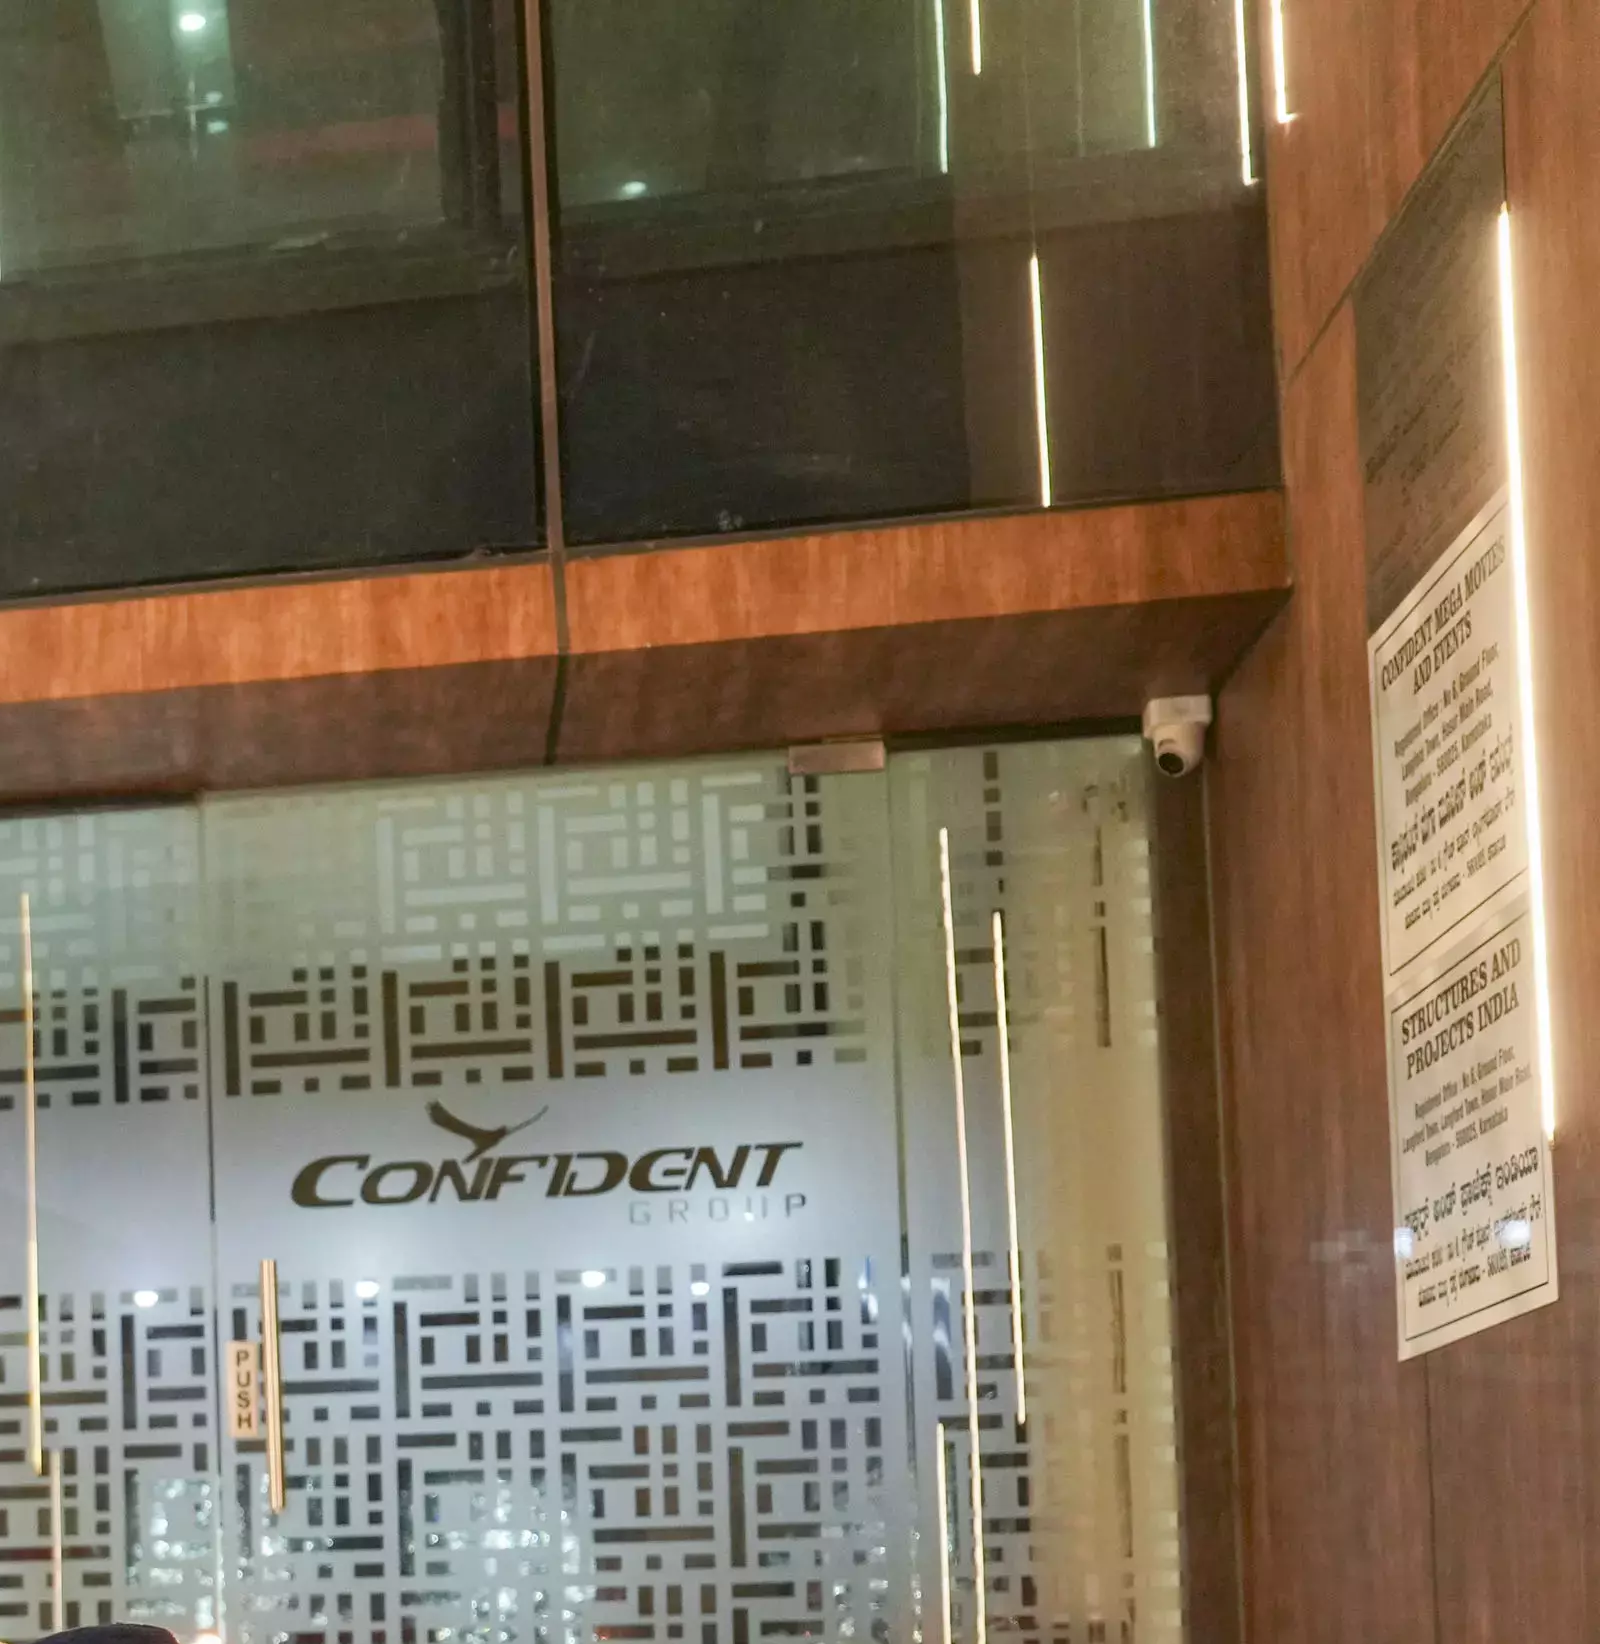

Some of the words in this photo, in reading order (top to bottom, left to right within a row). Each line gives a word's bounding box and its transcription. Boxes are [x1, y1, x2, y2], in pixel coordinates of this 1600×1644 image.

[1381, 613, 1433, 691] CONFIDENT
[1435, 582, 1464, 635] MEGA
[1413, 653, 1432, 695] AND
[1433, 609, 1473, 673] EVENTS
[1401, 961, 1488, 1046] STRUCTURES
[1490, 938, 1521, 982] AND
[1406, 1010, 1474, 1080] PROJECTS
[1477, 981, 1520, 1032] INDIA
[291, 1142, 803, 1208] CONFIDENT
[236, 1350, 253, 1429] PUSH
